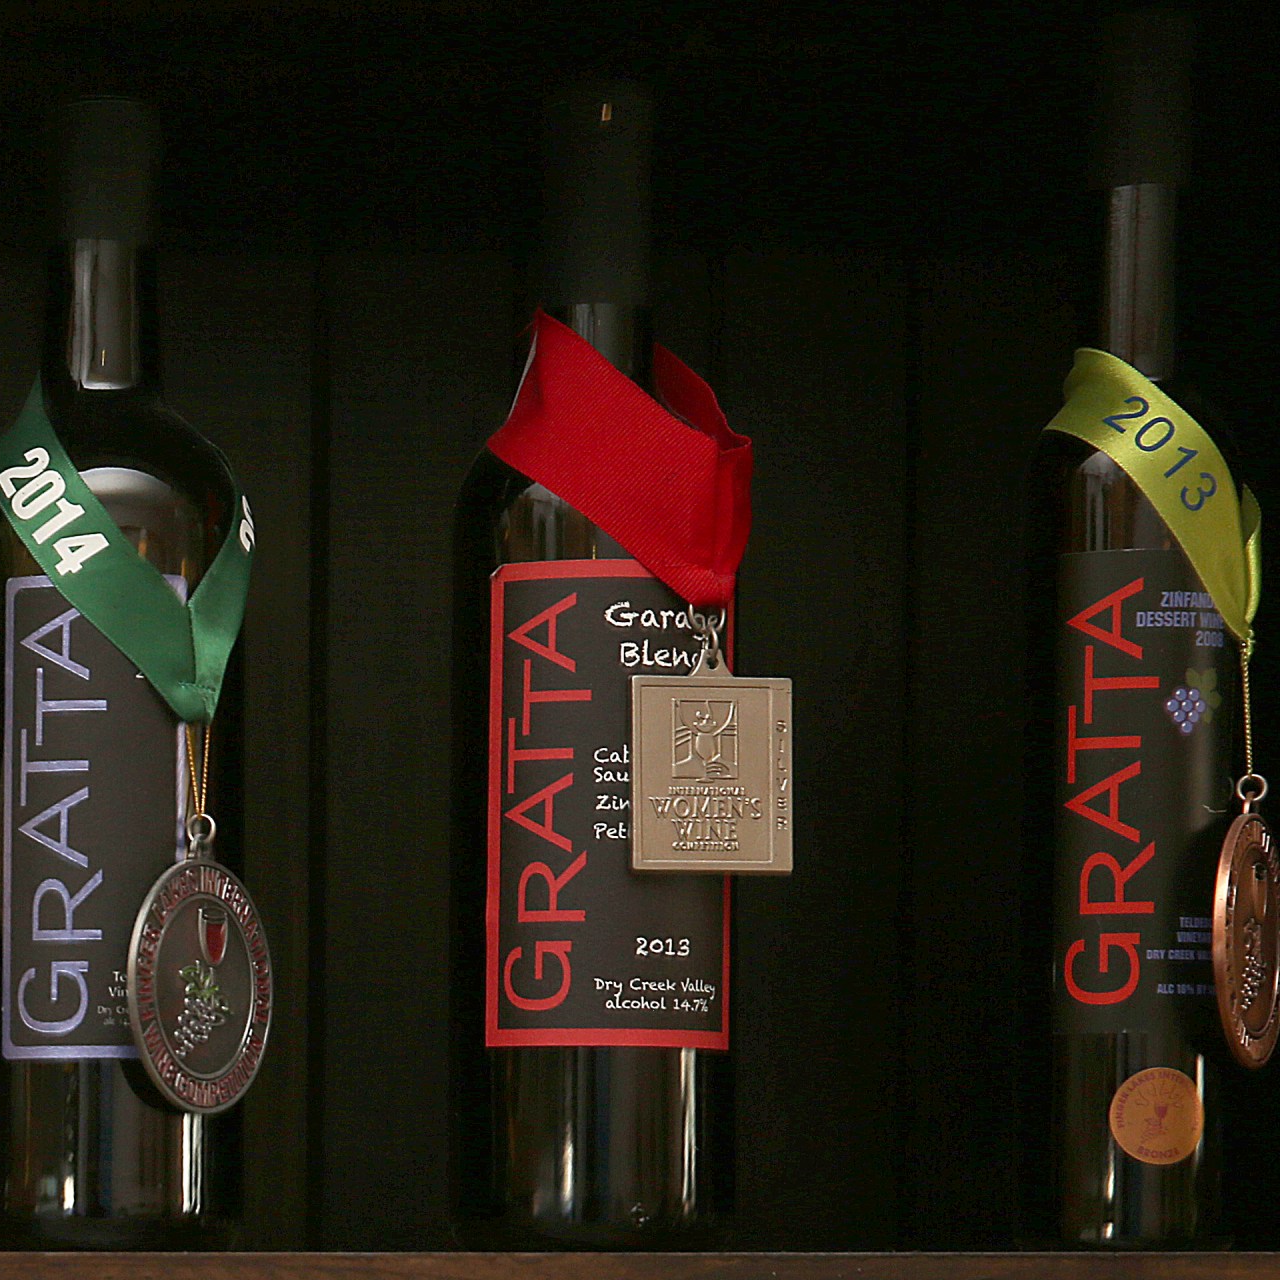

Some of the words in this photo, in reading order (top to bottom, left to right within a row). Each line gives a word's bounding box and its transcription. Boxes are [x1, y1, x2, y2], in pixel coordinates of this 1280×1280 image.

[1102, 395, 1217, 512] 2013
[1135, 611, 1197, 628] DESSERT
[593, 766, 630, 783] Sau
[776, 719, 788, 831] SILVER
[504, 592, 592, 1011] GRATTA
[1064, 577, 1160, 1005] GRATTA
[596, 795, 630, 810] Zin
[648, 796, 762, 820] WOMEN'S
[18, 608, 107, 1034] GRATTA
[594, 822, 630, 839] Pet
[671, 819, 738, 841] WINE
[635, 938, 690, 957] 2013
[1146, 949, 1166, 960] DRY
[594, 978, 623, 996] Dry
[630, 978, 677, 993] Creek
[681, 977, 716, 1000] Valley
[605, 994, 667, 1011] alcohol
[672, 998, 709, 1012] 14.7%
